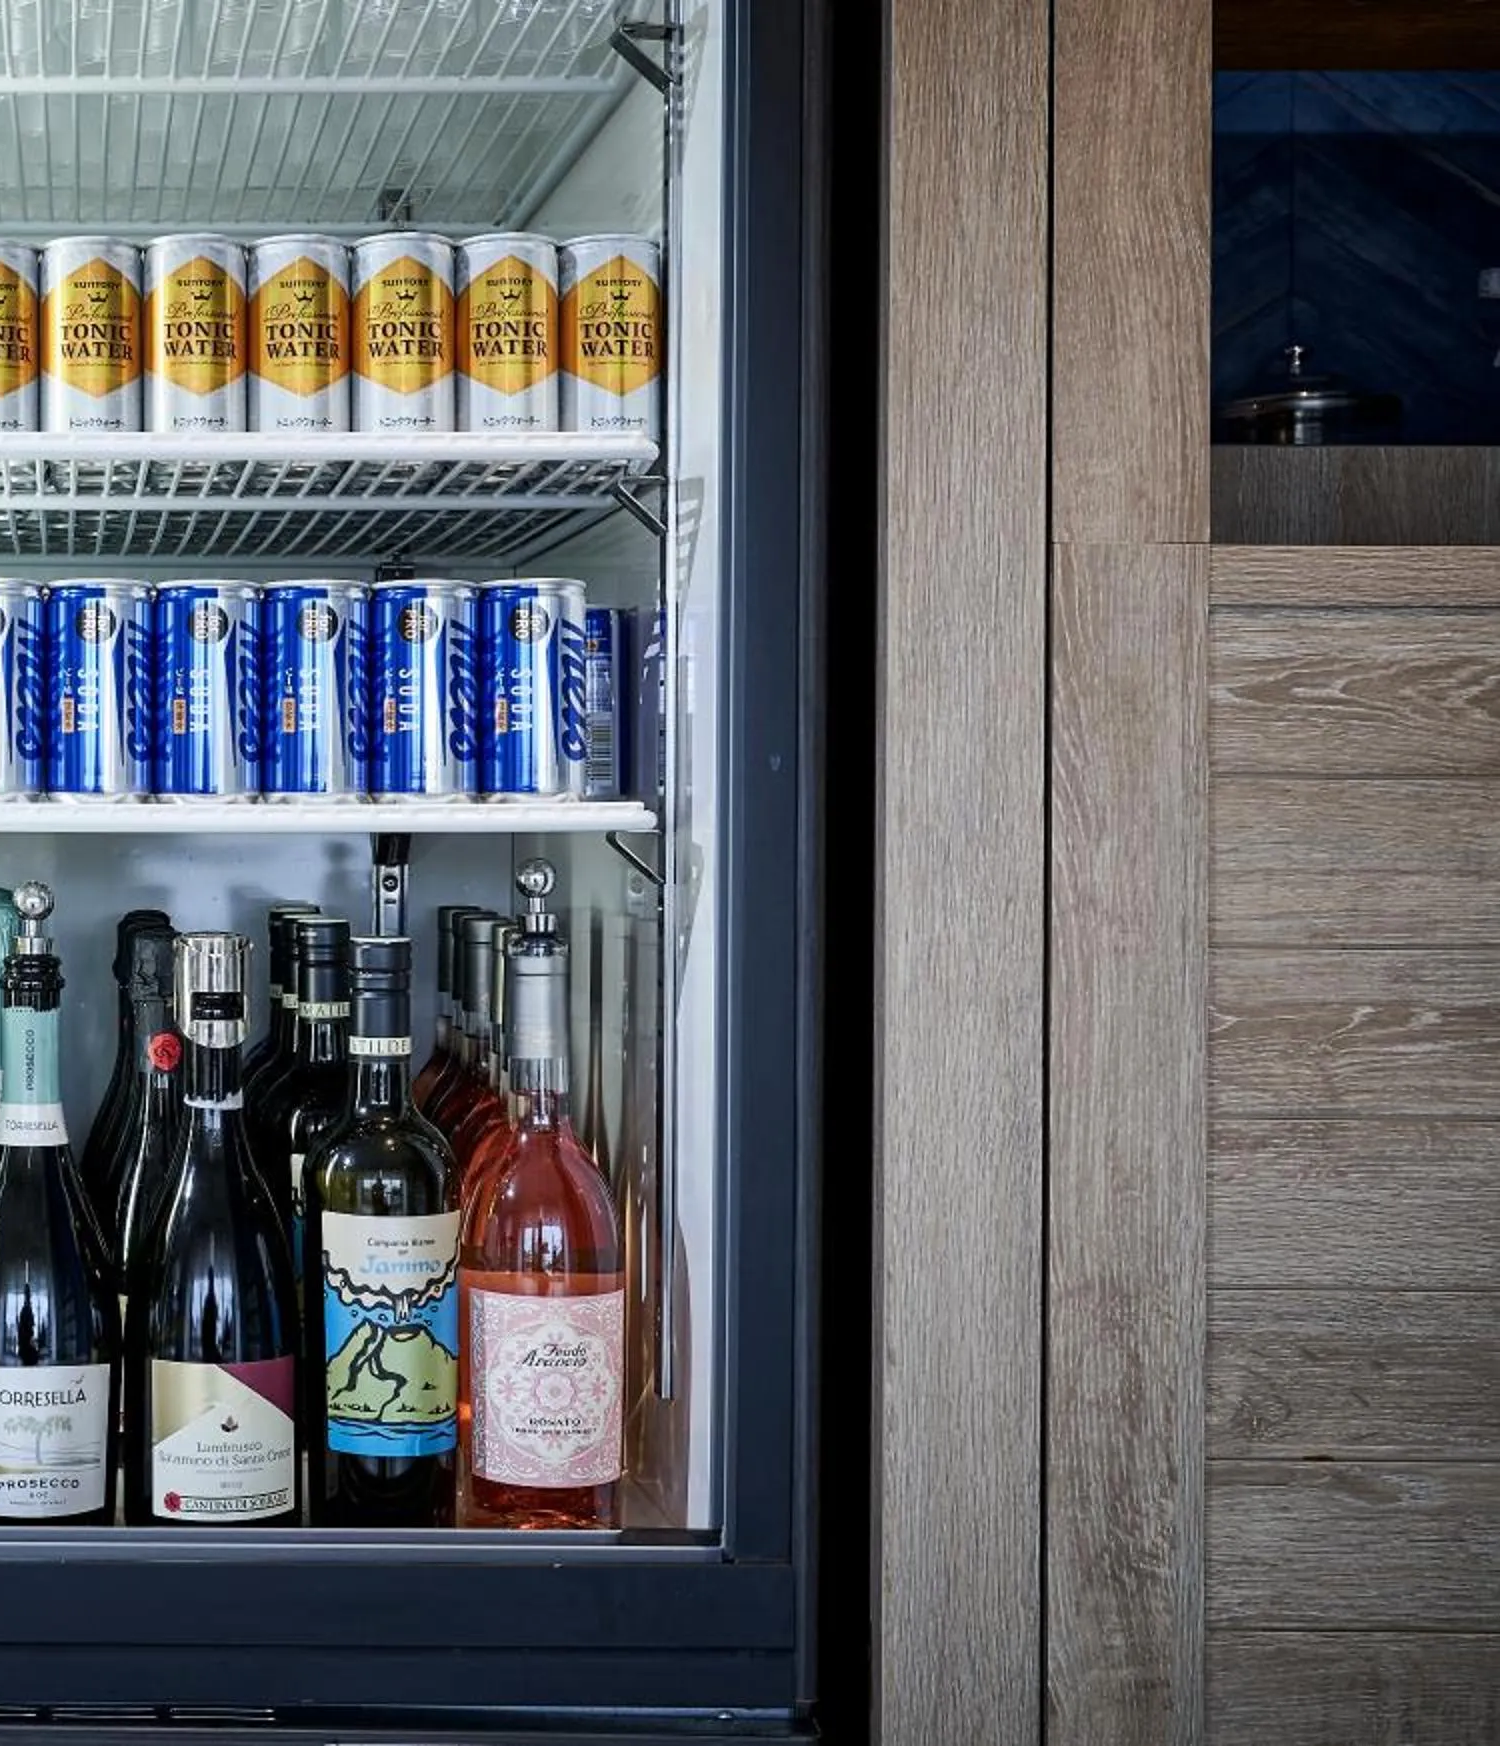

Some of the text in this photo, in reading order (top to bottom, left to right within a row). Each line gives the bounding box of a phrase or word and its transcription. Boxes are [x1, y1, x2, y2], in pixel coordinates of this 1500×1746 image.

[60, 323, 132, 341] TONIC
[164, 321, 236, 339] TONIC
[265, 323, 337, 341] TONIC
[368, 321, 441, 339] TONIC
[472, 321, 546, 339] TONIC
[580, 321, 653, 339] TONIC
[60, 341, 133, 360] WATER
[163, 339, 237, 359] WATER
[266, 341, 340, 360] WATER
[368, 339, 445, 360] WATER
[472, 339, 548, 359] WATER
[581, 340, 655, 361] WATER
[516, 609, 529, 639] PRO
[398, 668, 419, 732] SODA
[511, 667, 532, 732] SODA
[25, 1029, 35, 1091] PROSECCO
